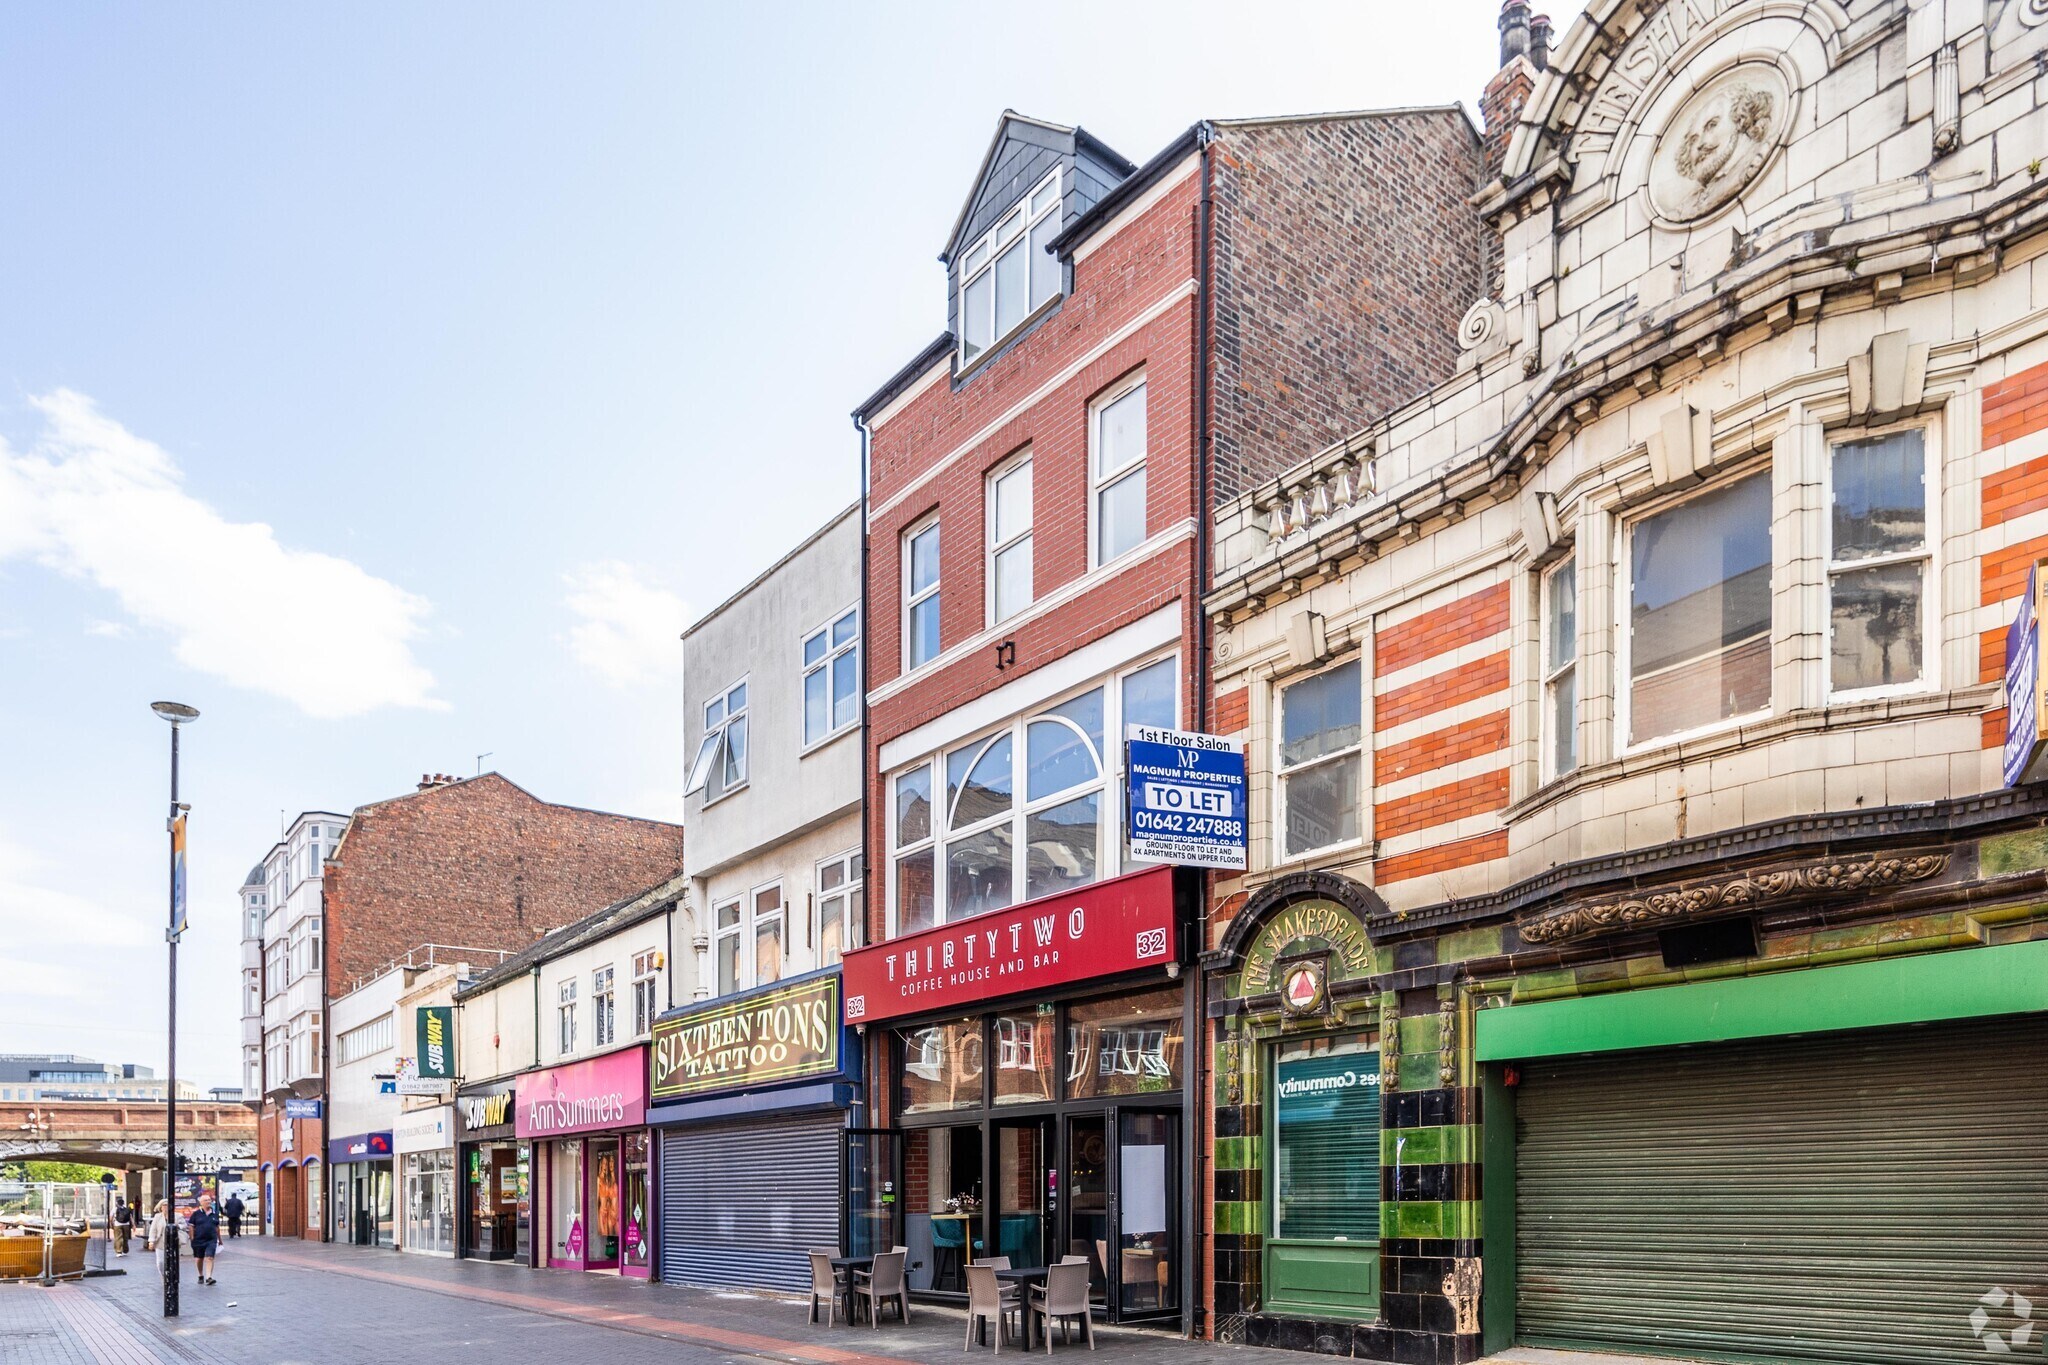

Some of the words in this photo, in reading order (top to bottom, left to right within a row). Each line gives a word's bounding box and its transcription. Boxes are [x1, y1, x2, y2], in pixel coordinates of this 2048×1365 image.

[1139, 728, 1158, 743] 1st
[1162, 731, 1193, 747] Floor
[1197, 736, 1231, 751] Salon
[1133, 764, 1181, 778] MAGNUM
[1183, 770, 1242, 784] PROPERTIES
[1153, 787, 1183, 808] TO
[1190, 791, 1225, 813] LET
[1135, 811, 1183, 832] 01642
[1186, 816, 1242, 837] 247888
[1136, 831, 1242, 847] magnumproperties.co.uk
[1146, 841, 1173, 850] GROUND
[1174, 844, 1195, 852] FLOOR
[1197, 845, 1206, 853] TO
[1206, 846, 1218, 854] LET
[1143, 849, 1186, 860] APARTMENTS
[1198, 854, 1218, 862] UPPER
[1220, 856, 1244, 864] FLOORS
[885, 907, 1085, 982] THIRTYTWO
[1137, 932, 1166, 957] 32
[901, 976, 943, 997] COFFEE
[951, 968, 991, 986] HOUSE
[999, 958, 1025, 975] AND
[1033, 951, 1060, 968] BAR
[1246, 954, 1266, 990] THE
[848, 996, 865, 1017] 32
[426, 1009, 445, 1075] SUBWAY
[657, 1013, 754, 1085] SIXTEEN
[757, 999, 828, 1054] TONS
[685, 1043, 787, 1078] TATTOO
[287, 1105, 317, 1113] HALIFAX
[465, 1090, 512, 1131] SUBWAY
[529, 1098, 555, 1131] Ann
[557, 1092, 623, 1129] Summers
